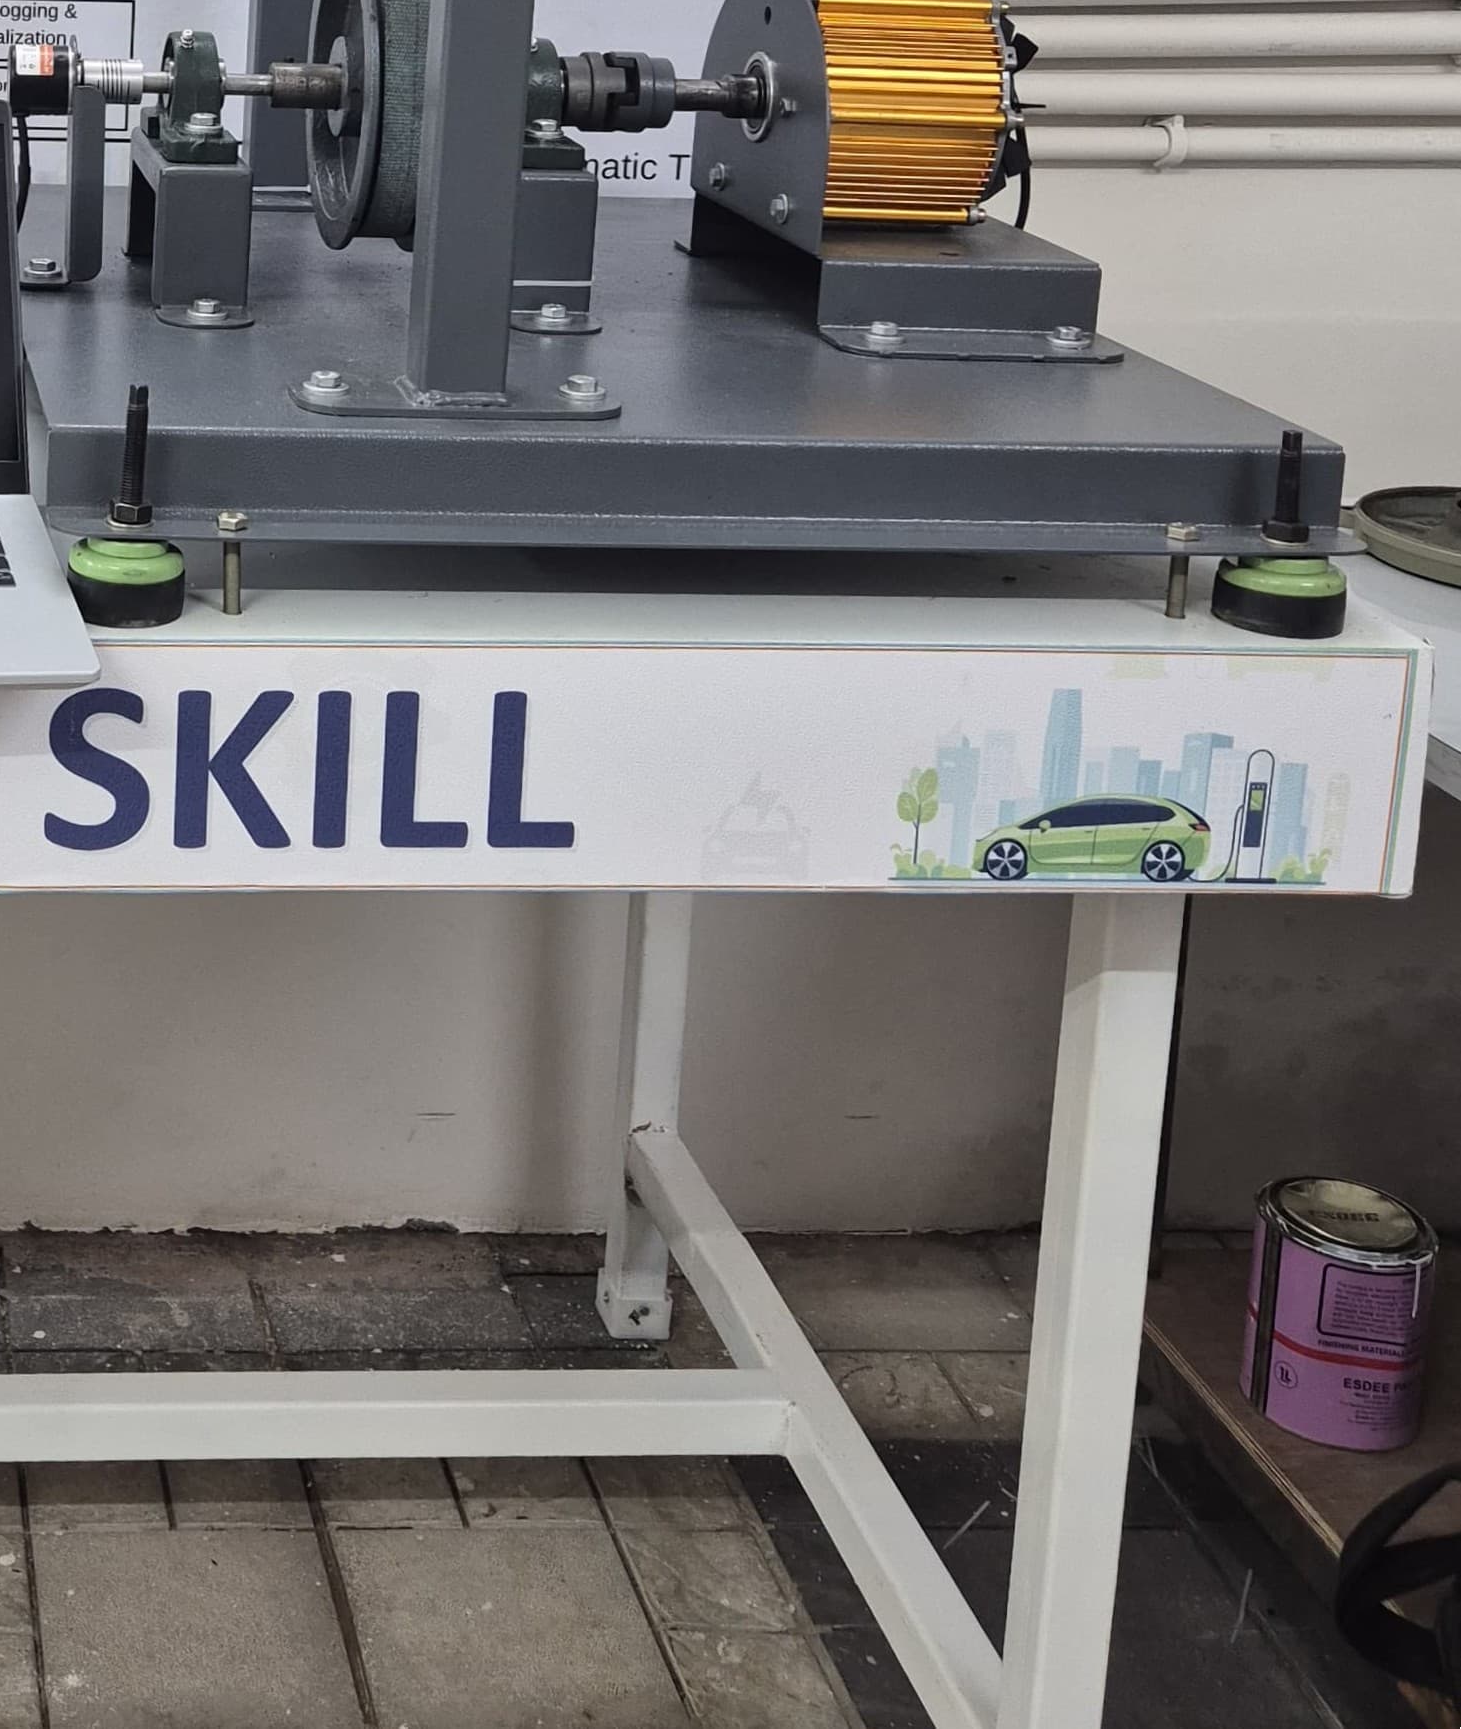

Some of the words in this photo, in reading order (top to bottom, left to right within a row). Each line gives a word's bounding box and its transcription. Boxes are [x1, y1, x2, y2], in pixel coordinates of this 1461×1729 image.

[64, 3, 78, 19] &
[42, 686, 576, 855] SKILL
[1343, 1377, 1390, 1393] ESDEE
